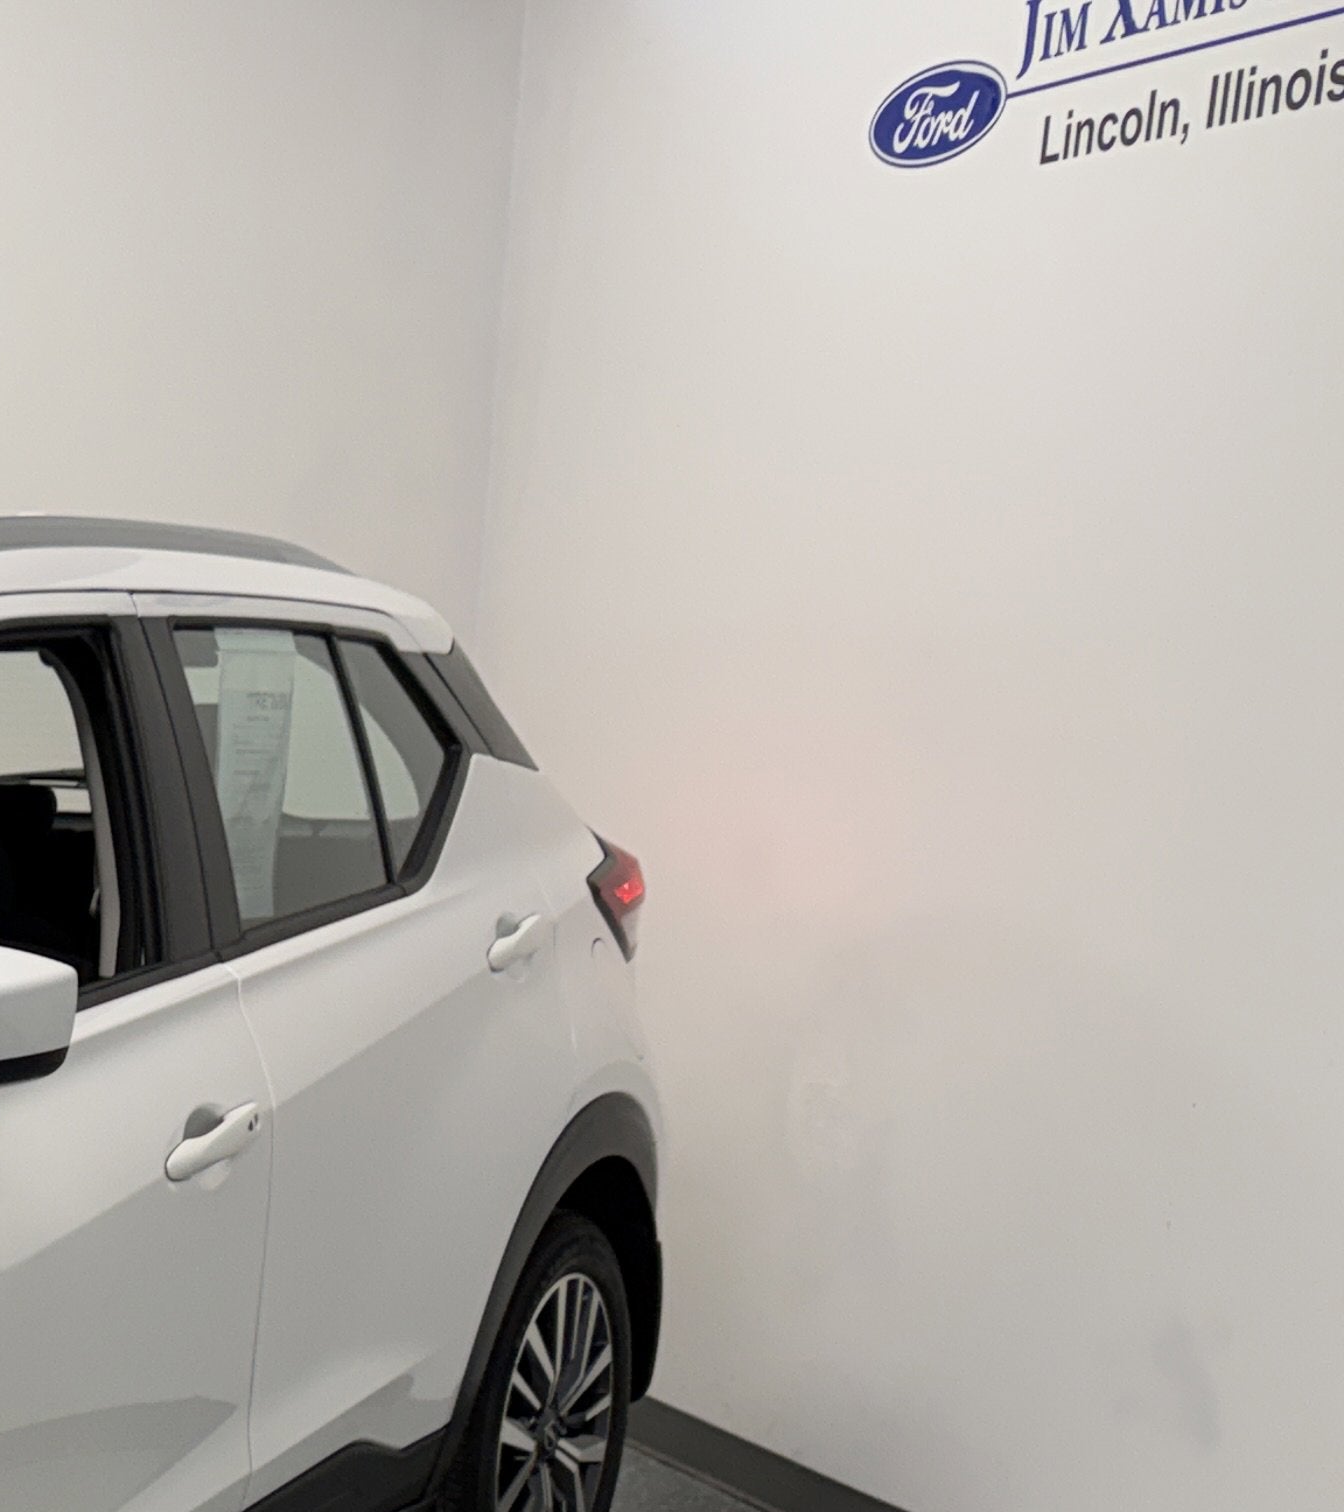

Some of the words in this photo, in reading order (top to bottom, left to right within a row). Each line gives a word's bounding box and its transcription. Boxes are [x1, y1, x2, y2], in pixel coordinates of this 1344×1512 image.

[1016, 0, 1092, 80] JIM
[893, 80, 981, 154] Ford
[1040, 89, 1190, 166] Lincoln,
[1205, 47, 1344, 130] Illinois
